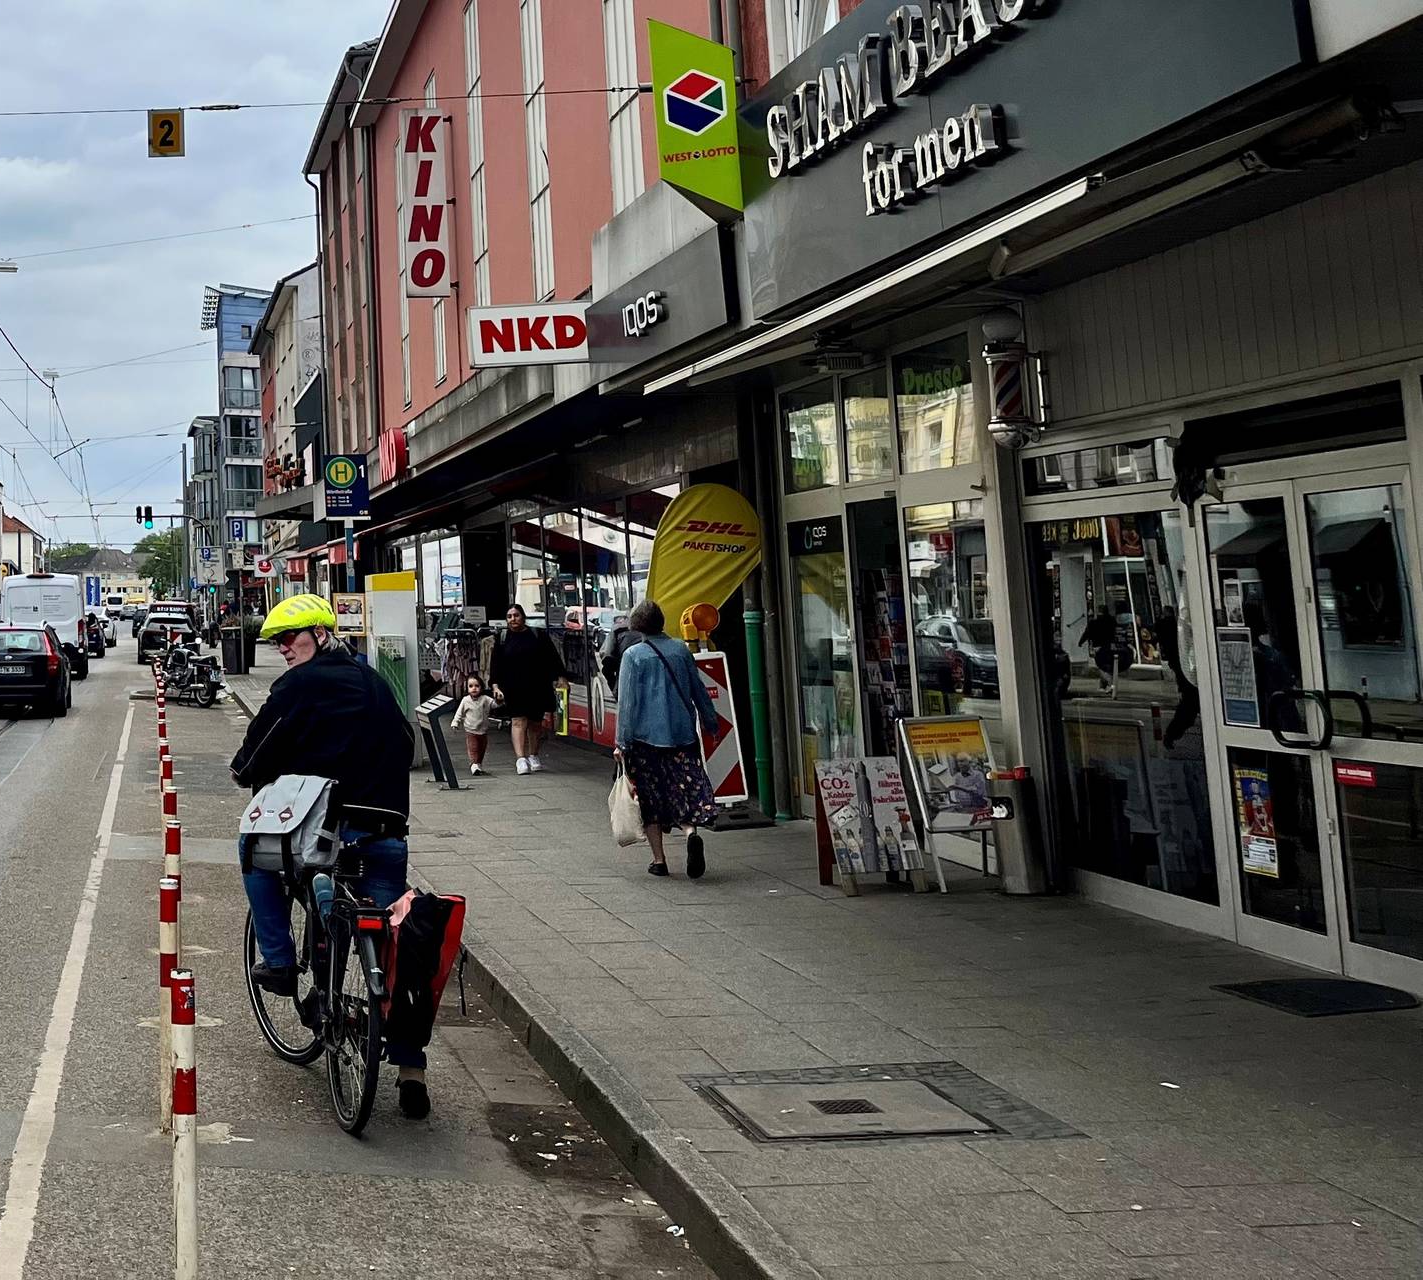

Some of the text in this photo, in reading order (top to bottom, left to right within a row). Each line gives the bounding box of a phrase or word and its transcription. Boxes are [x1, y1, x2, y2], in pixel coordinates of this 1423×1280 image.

[767, 0, 1025, 178] SHAM BEA
[159, 119, 174, 147] 2
[663, 145, 737, 163] WEST LOTTO
[862, 104, 997, 216] for men
[405, 115, 445, 288] KINO
[621, 290, 660, 338] IQOS
[479, 314, 587, 354] NKD
[902, 365, 963, 394] Presse
[358, 464, 365, 478] 1
[686, 520, 746, 536] DHL
[682, 541, 746, 553] PAKETSHOP
